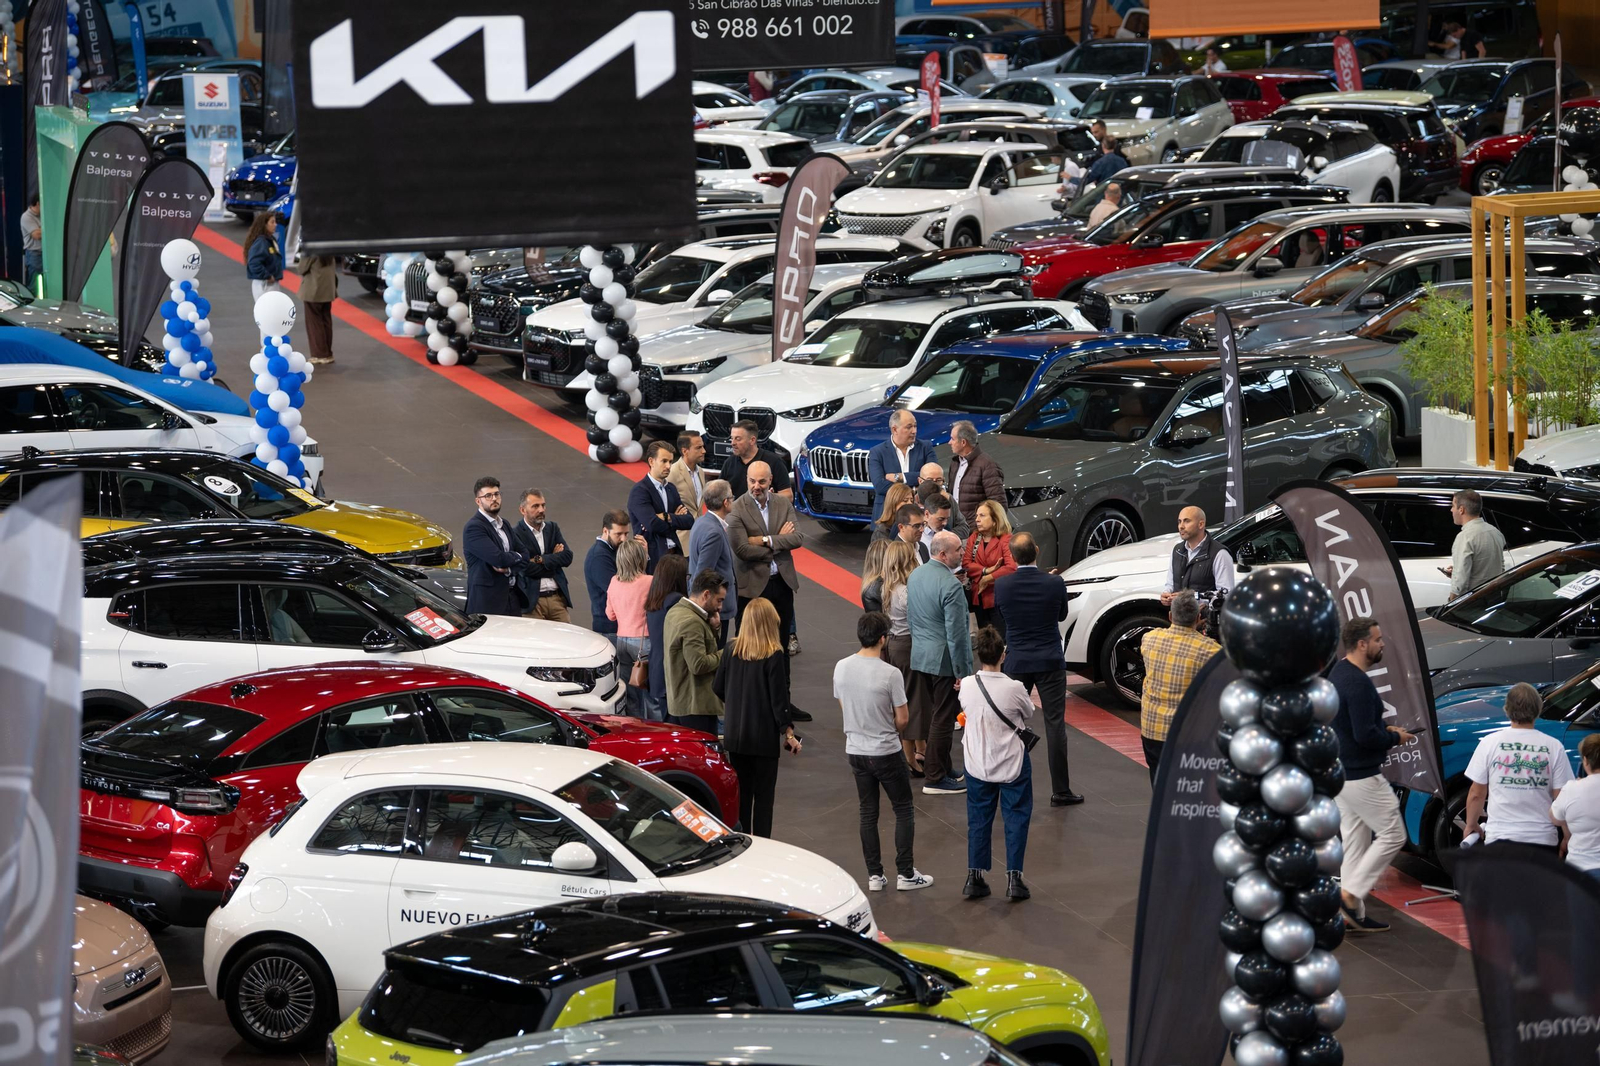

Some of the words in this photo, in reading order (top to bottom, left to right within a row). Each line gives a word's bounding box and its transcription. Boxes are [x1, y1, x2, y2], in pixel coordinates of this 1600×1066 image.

[718, 18, 758, 38] 988
[765, 17, 802, 37] 661
[812, 15, 853, 35] 002
[89, 151, 147, 163] VOLVO
[86, 164, 133, 178] Balpersa
[144, 190, 208, 202] VOLVO
[141, 205, 192, 219] Balpersa
[1176, 776, 1205, 794] that
[1170, 800, 1220, 820] inspires
[156, 821, 170, 830] C4
[560, 884, 587, 895] Bétula
[589, 888, 607, 897] Cars
[401, 909, 461, 926] NUEVO
